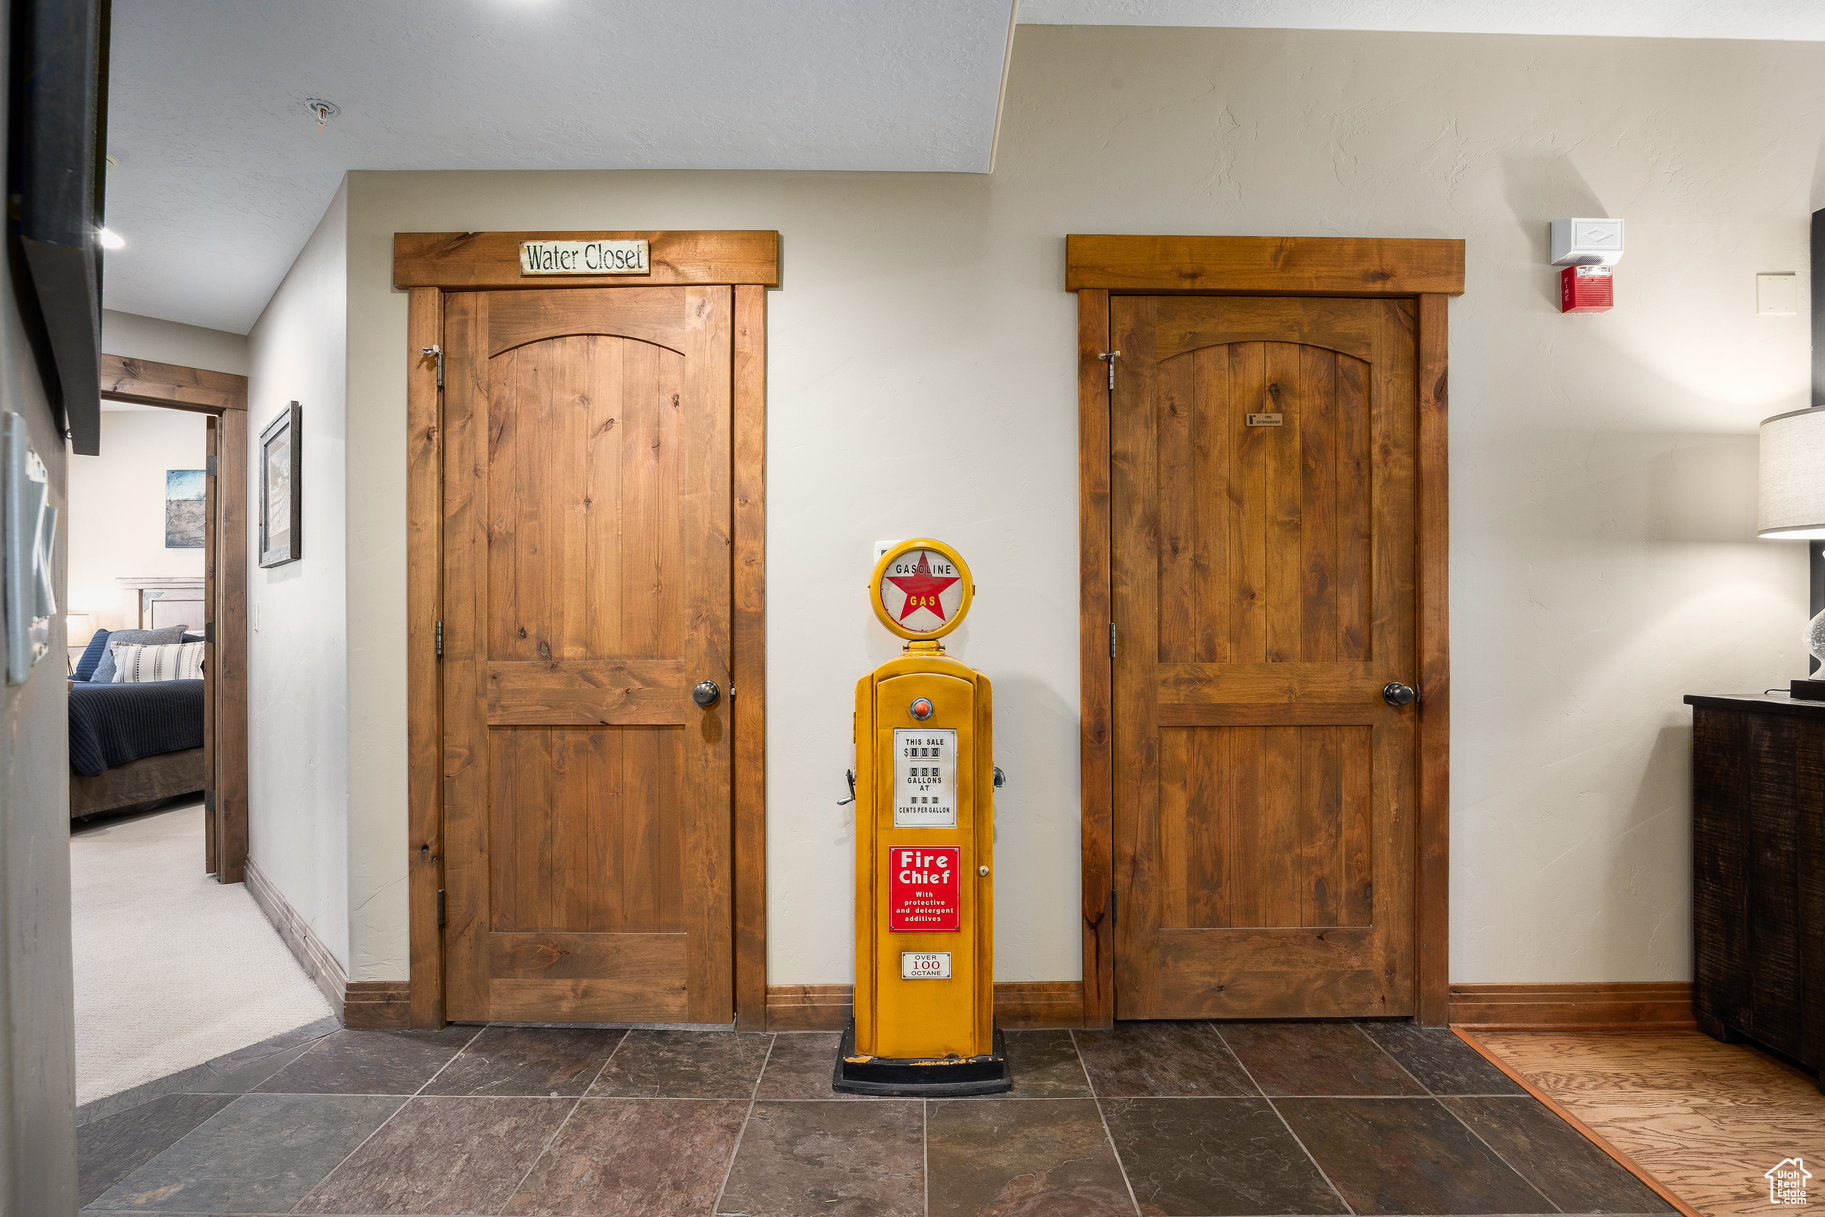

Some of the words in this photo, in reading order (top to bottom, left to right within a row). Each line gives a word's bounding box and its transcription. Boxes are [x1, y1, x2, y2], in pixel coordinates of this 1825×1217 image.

[526, 245, 578, 270] Water
[584, 243, 643, 270] Closet
[895, 564, 951, 574] GASOLINE
[910, 596, 936, 606] GAS
[901, 851, 948, 868] Fire
[899, 869, 951, 884] Chief
[904, 899, 945, 907] protective
[915, 907, 954, 915] detergent
[913, 960, 940, 970] 100
